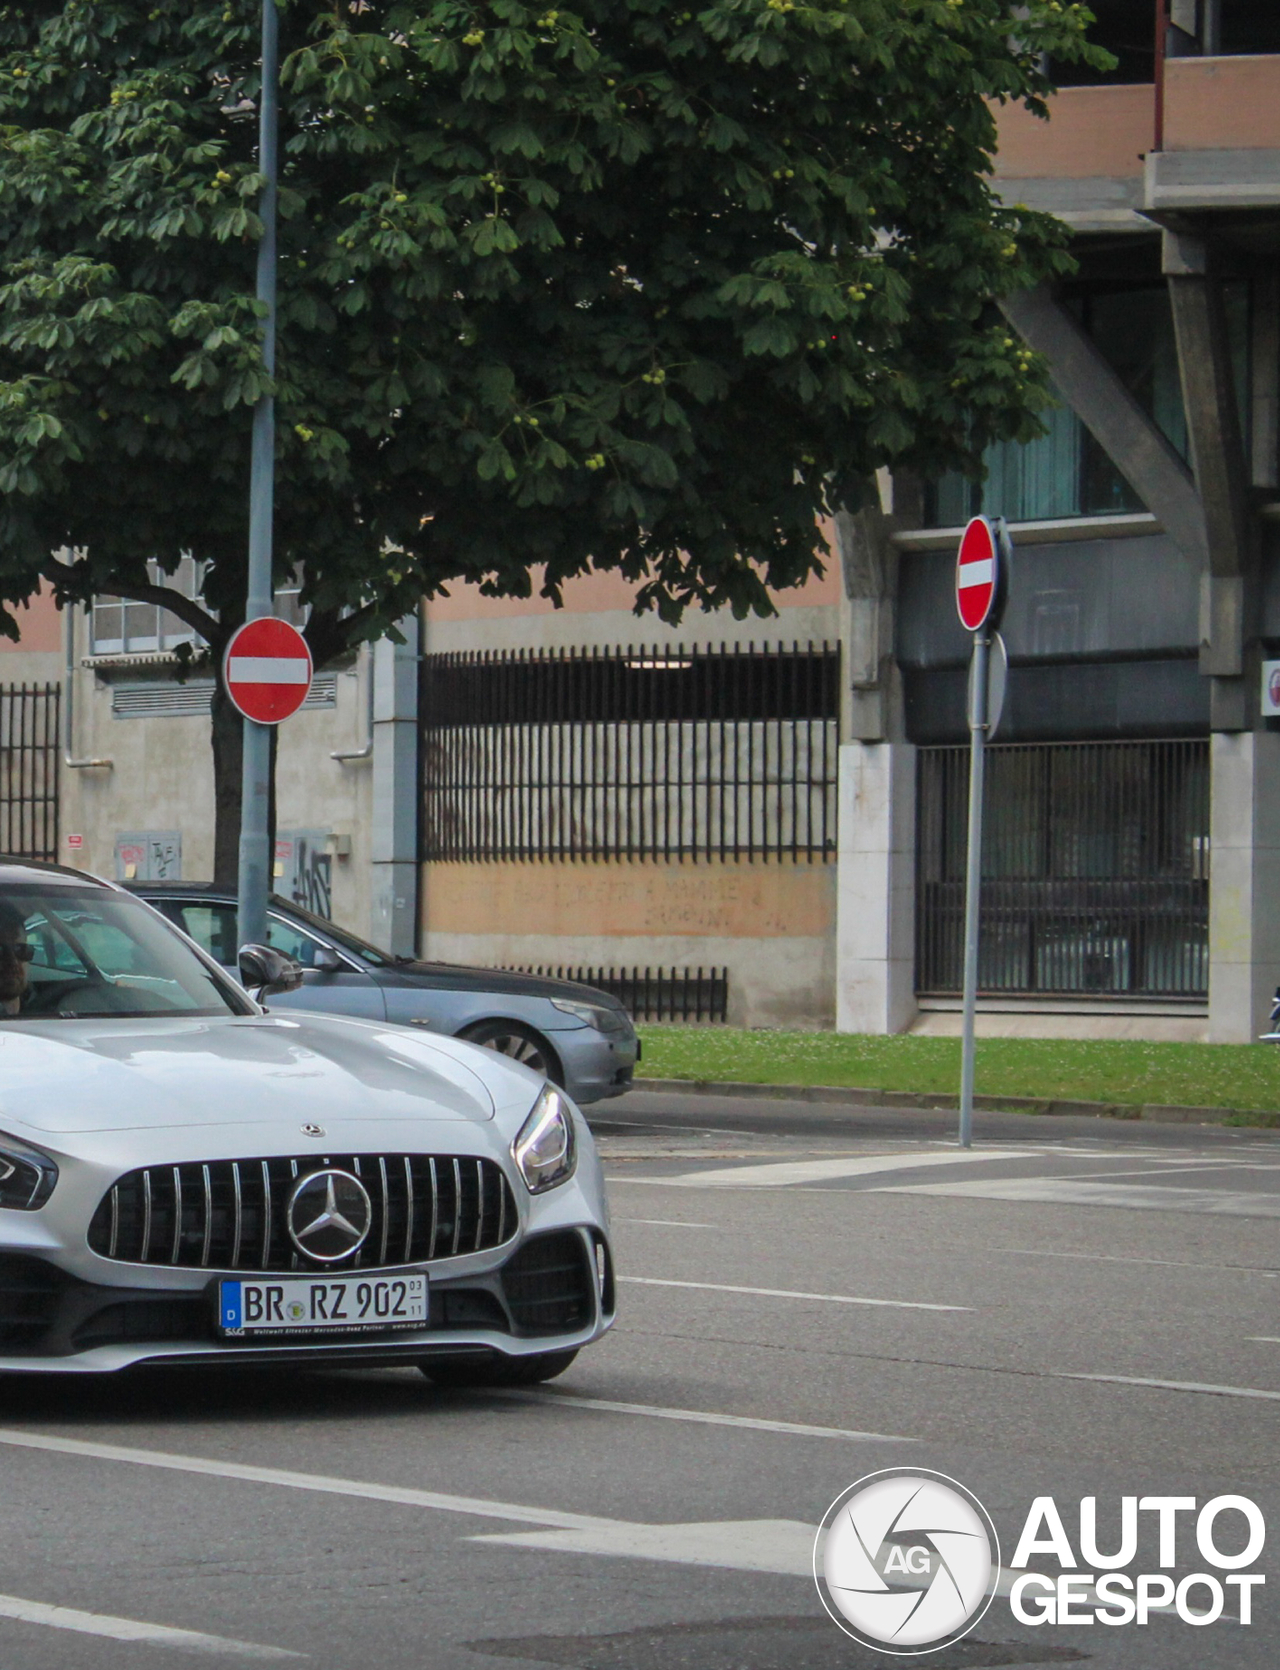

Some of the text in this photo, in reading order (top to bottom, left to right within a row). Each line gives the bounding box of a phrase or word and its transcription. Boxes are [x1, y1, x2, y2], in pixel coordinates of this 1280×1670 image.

[410, 1281, 422, 1291] 03
[245, 1281, 406, 1321] BR RZ 902
[227, 1309, 236, 1321] D
[411, 1305, 422, 1315] 11
